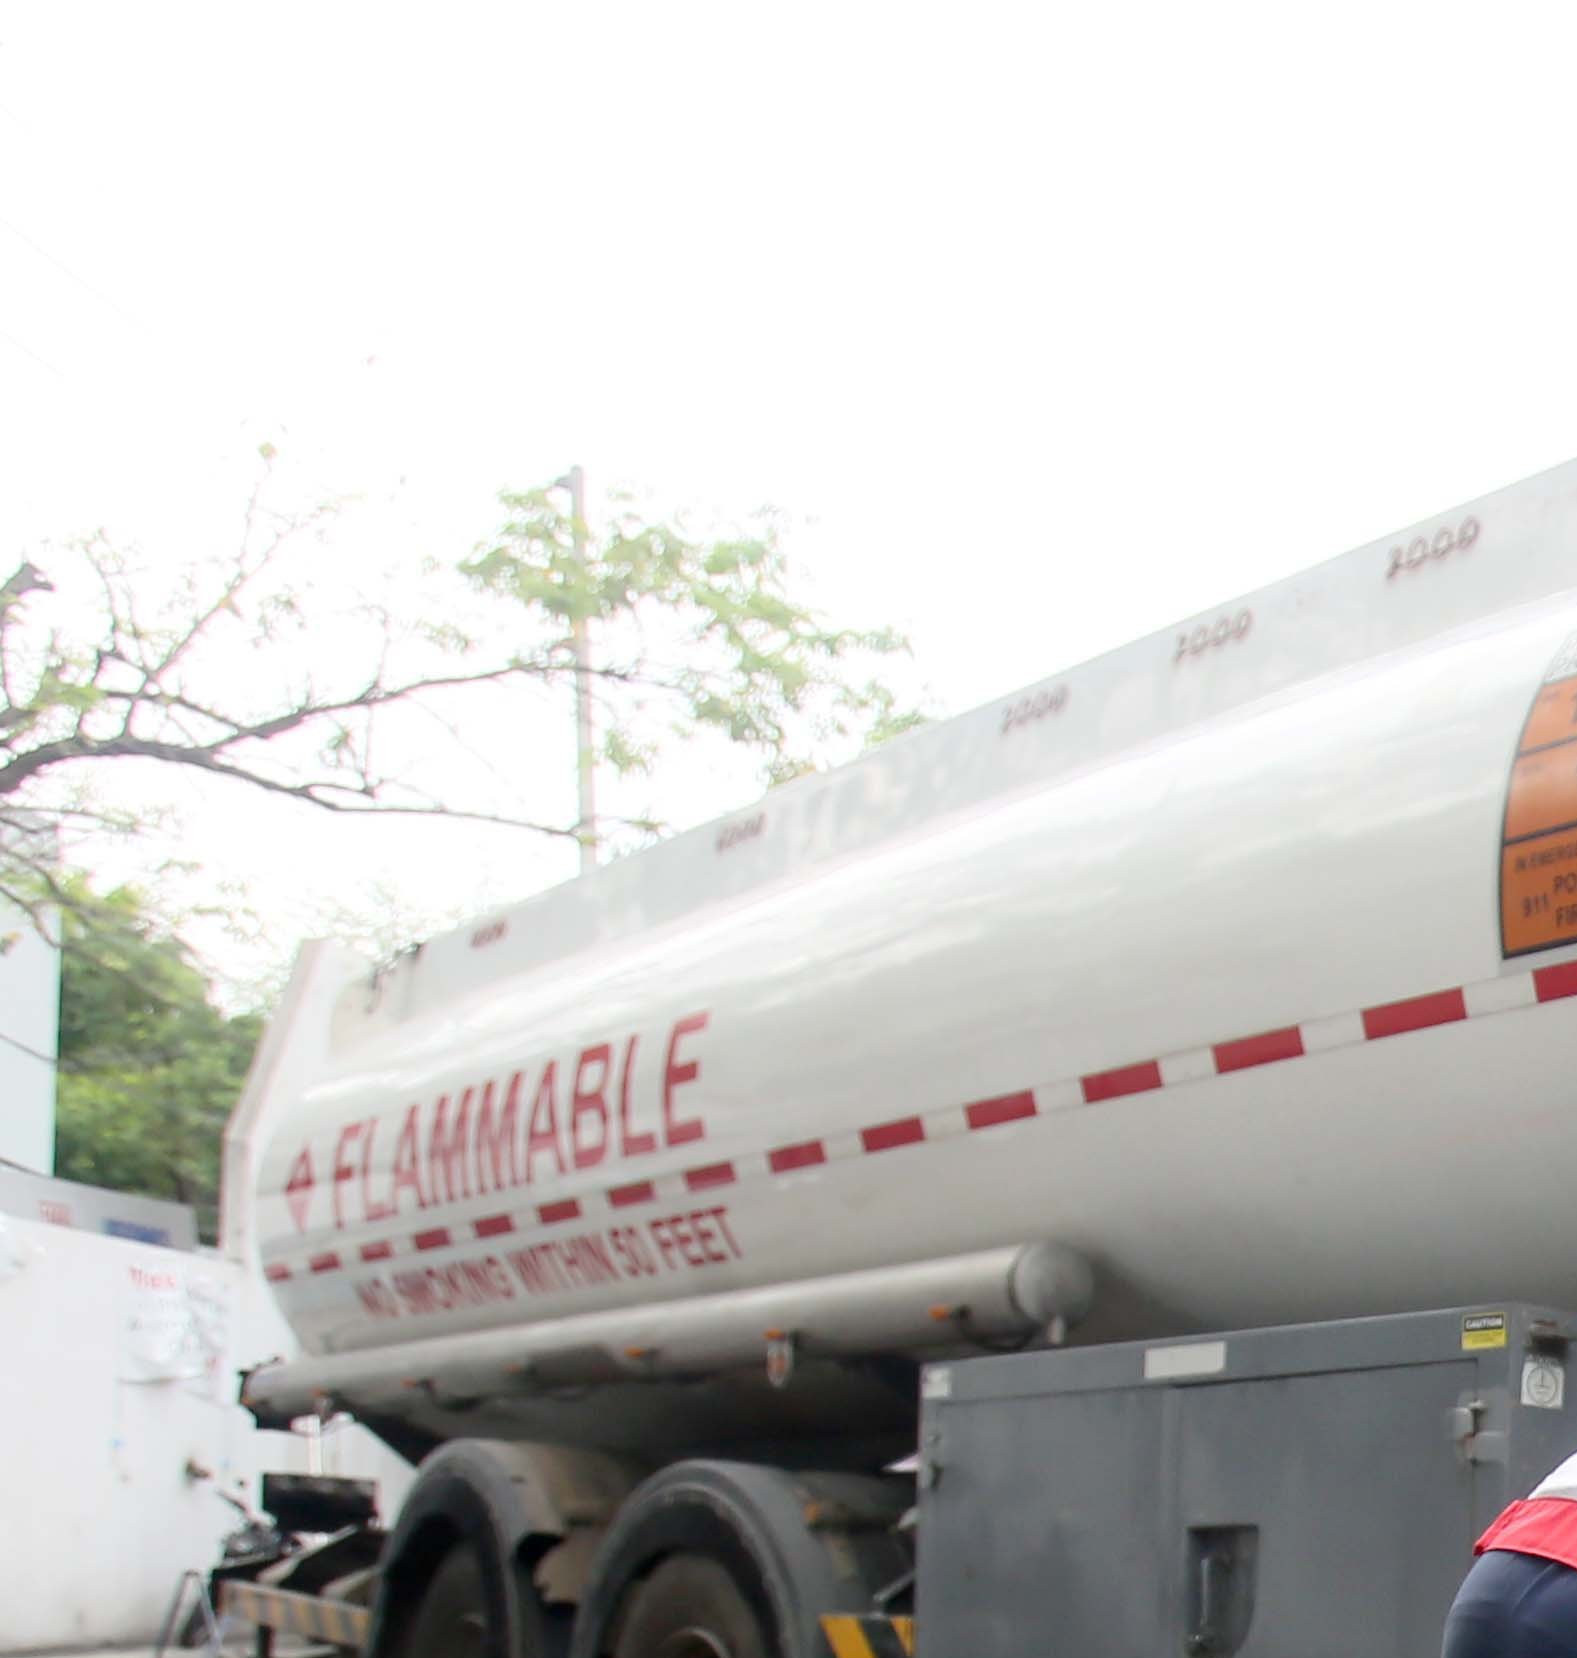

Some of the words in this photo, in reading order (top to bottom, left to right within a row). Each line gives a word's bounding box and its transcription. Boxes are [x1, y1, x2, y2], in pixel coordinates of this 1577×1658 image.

[333, 1011, 709, 1230] FLAMMABLE
[392, 1256, 514, 1316] SMOKING
[506, 1232, 621, 1296] WITHIN
[649, 1205, 743, 1271] FEET
